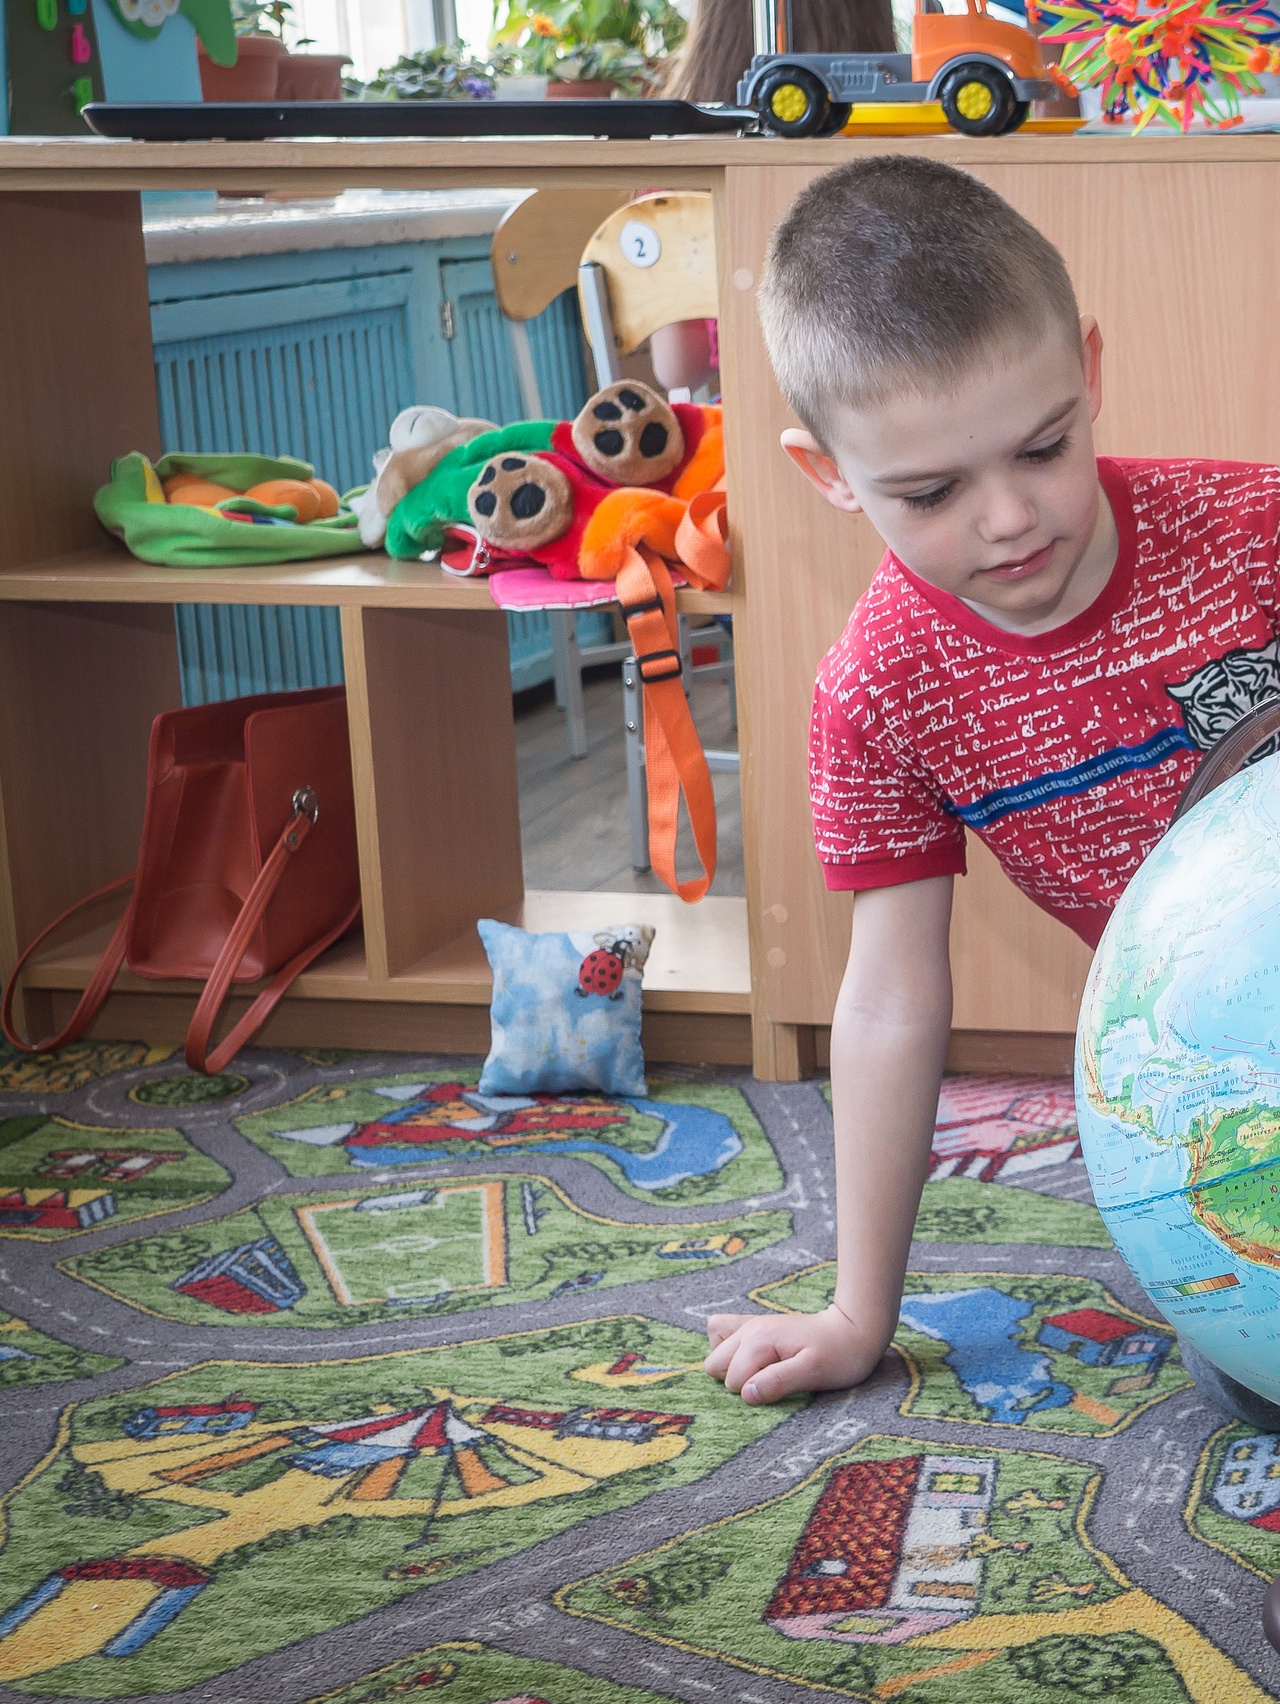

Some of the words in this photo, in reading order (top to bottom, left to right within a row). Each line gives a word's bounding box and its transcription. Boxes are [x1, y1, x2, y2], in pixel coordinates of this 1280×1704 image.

[634, 236, 647, 258] 2
[1226, 988, 1263, 1007] МОРЕ
[1222, 1074, 1246, 1089] МОРЕ
